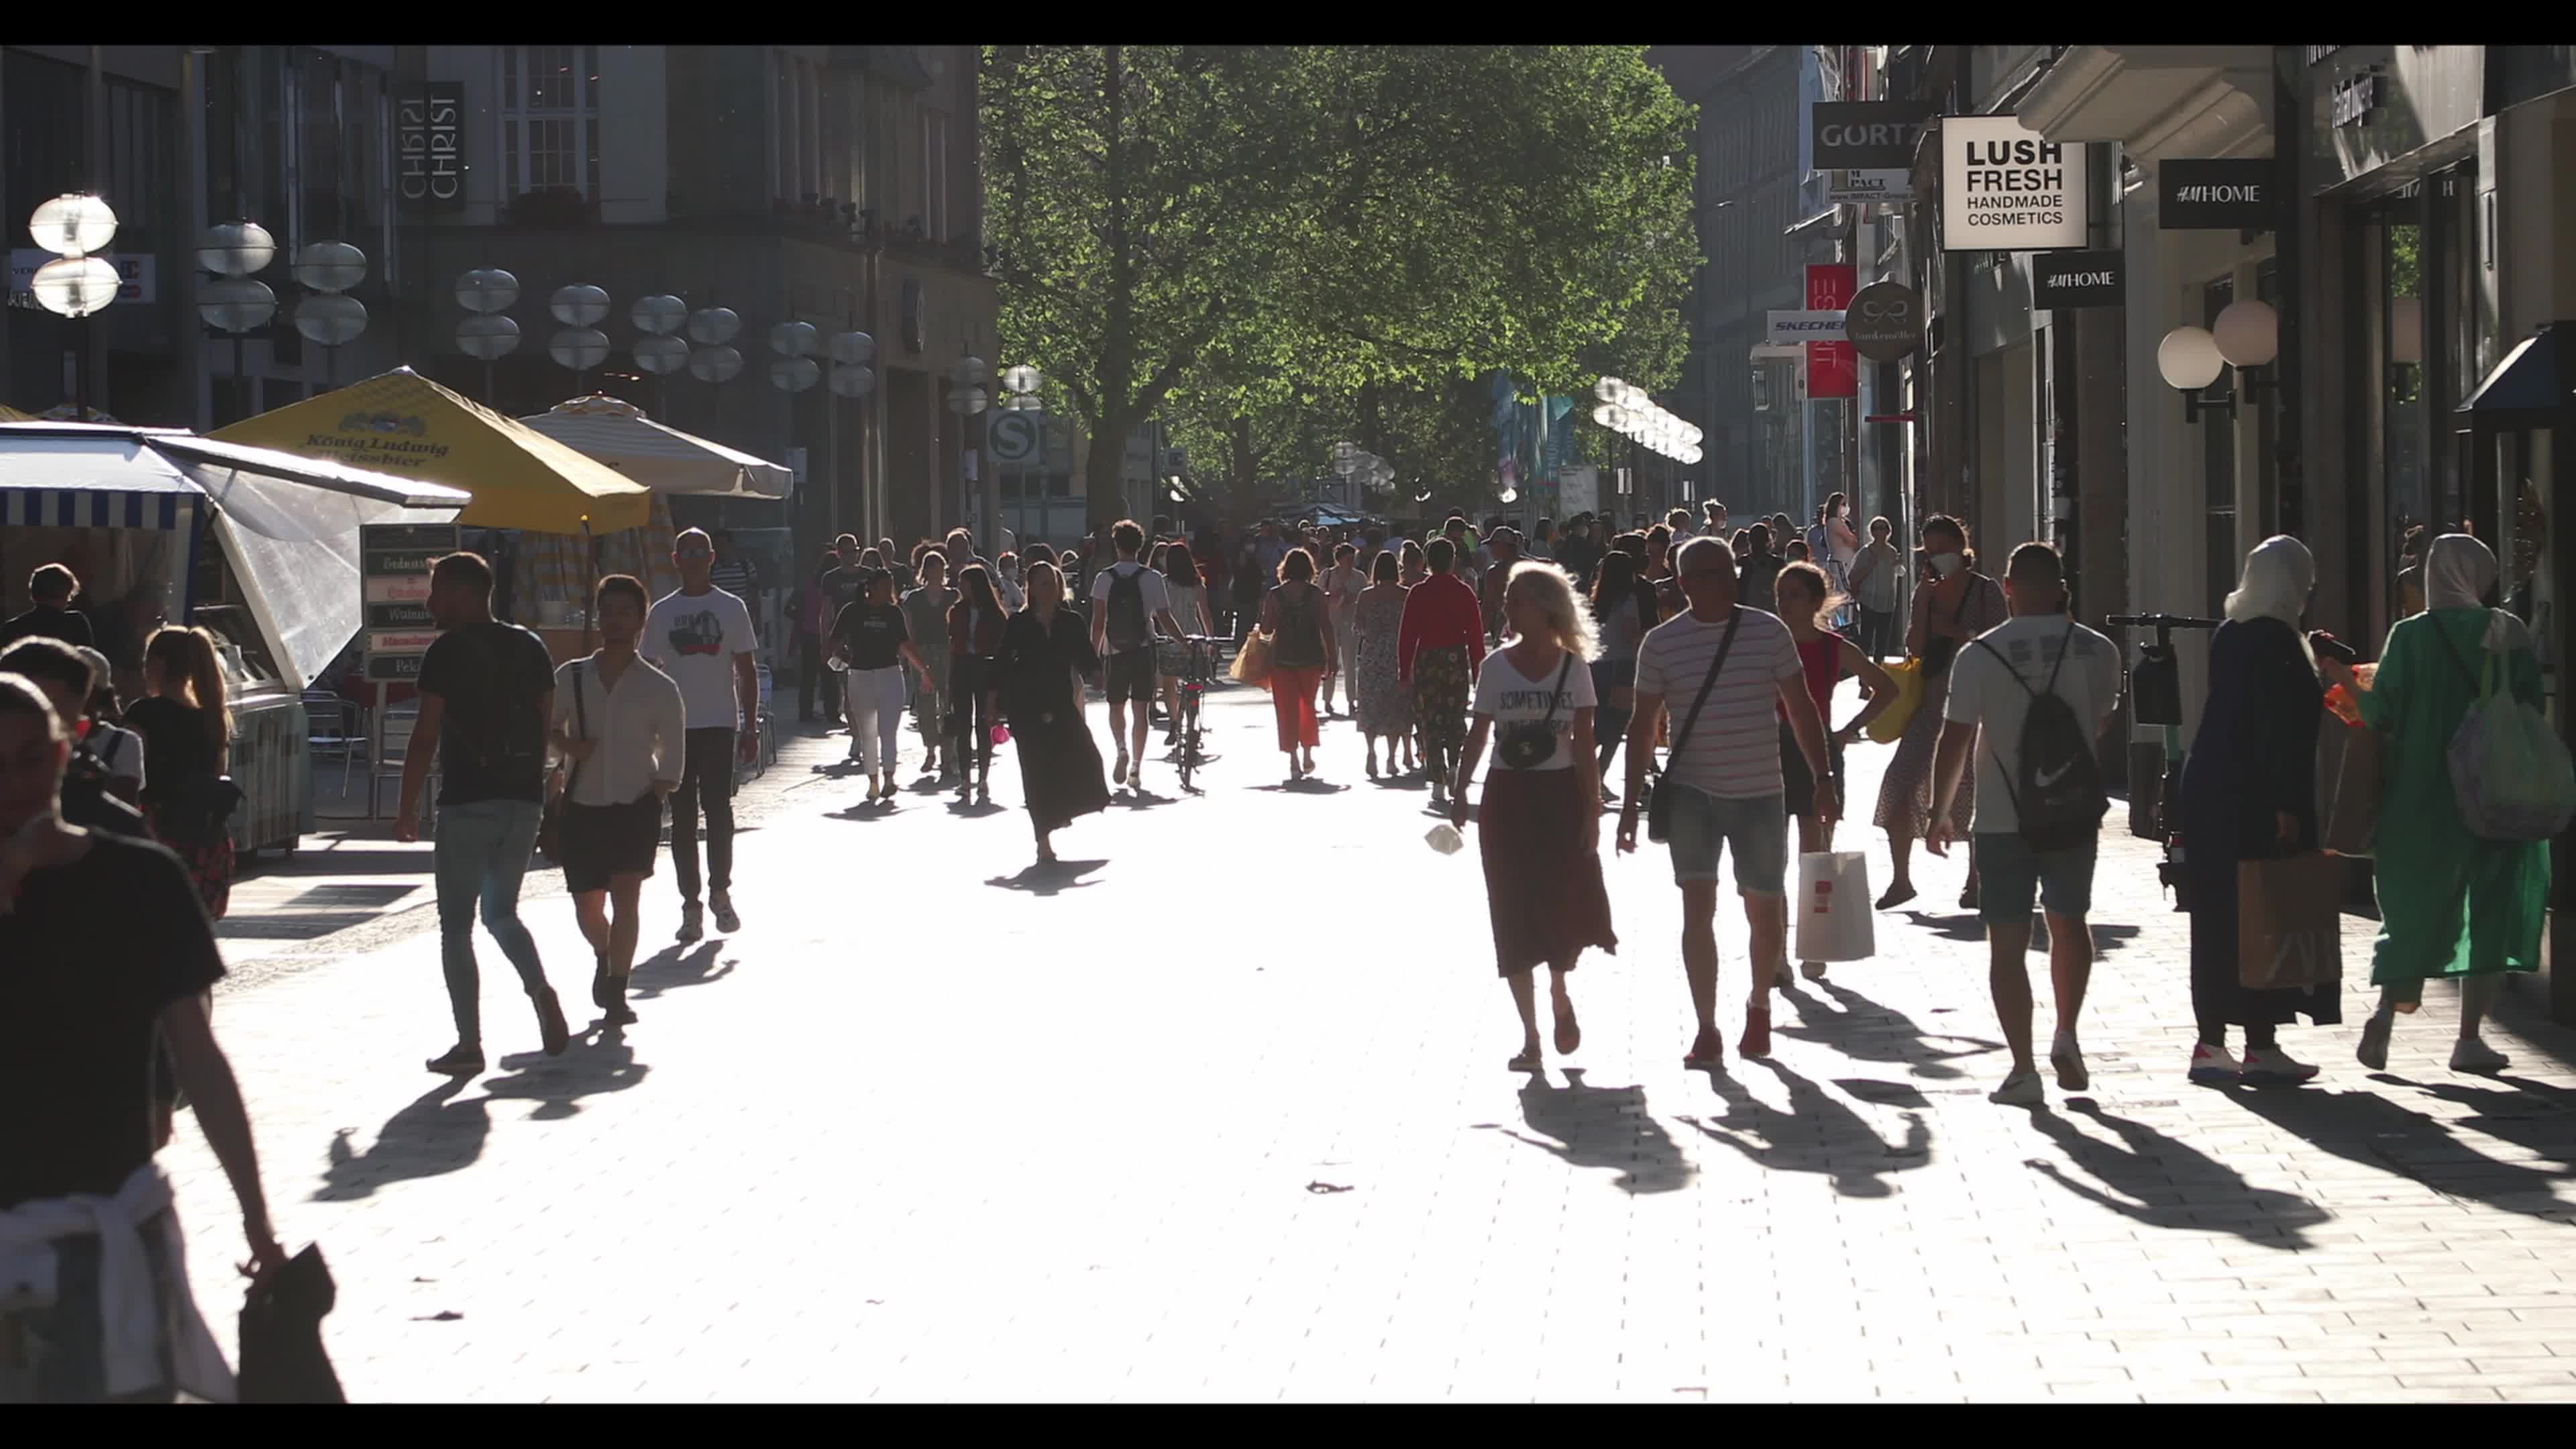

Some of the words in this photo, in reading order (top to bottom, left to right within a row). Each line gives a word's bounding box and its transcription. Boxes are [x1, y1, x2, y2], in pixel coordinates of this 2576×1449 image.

[430, 93, 458, 199] CHRIST
[1967, 140, 2061, 166] LUSH
[1967, 168, 2062, 192] FRESH
[1967, 195, 2063, 209] HANDMADE
[2202, 184, 2260, 203] HOME
[1968, 211, 2063, 226] COSMETICS
[2068, 271, 2114, 286] HOME
[368, 437, 450, 457] Ludwig
